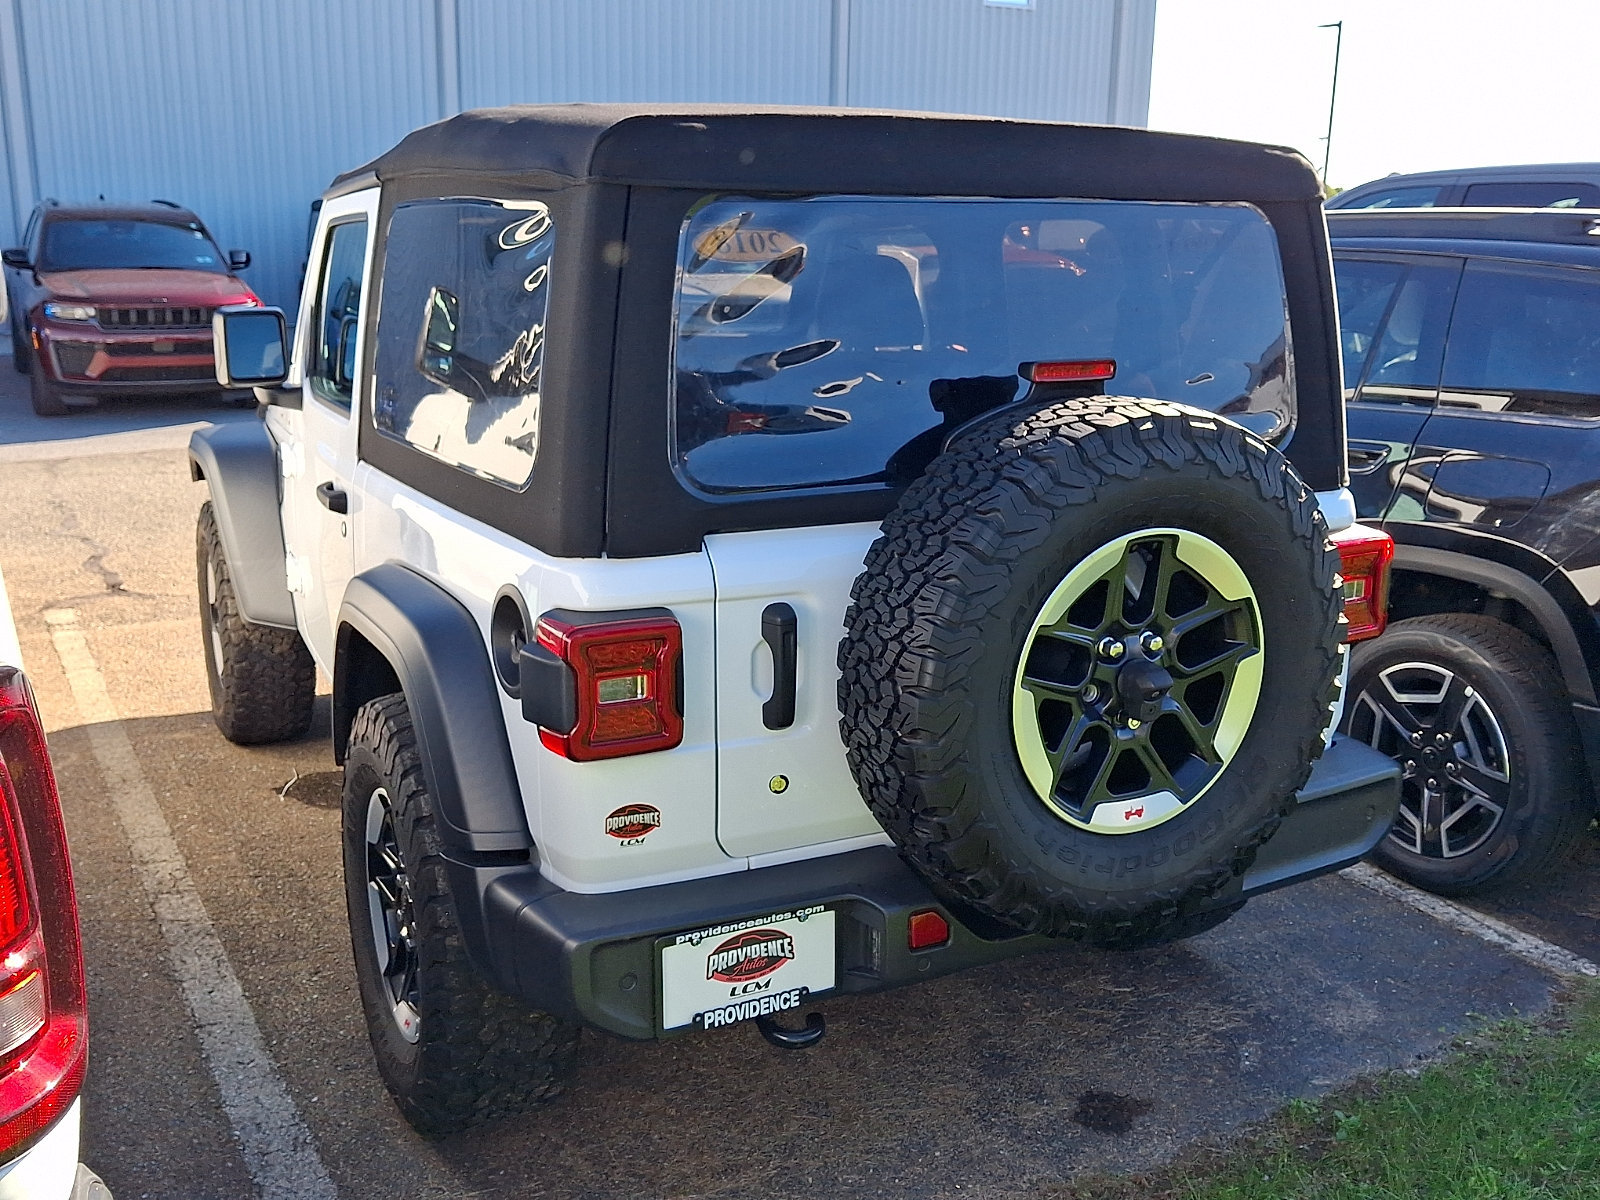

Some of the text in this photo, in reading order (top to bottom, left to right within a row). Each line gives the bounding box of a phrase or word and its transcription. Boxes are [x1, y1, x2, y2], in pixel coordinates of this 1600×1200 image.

[606, 811, 660, 833] PROVIDENCE
[675, 905, 825, 945] providenceautos.com
[708, 937, 793, 979] PROVIDENCE
[729, 957, 768, 978] Autos
[730, 978, 772, 997] LCM
[703, 989, 800, 1030] PROVIDENCE
